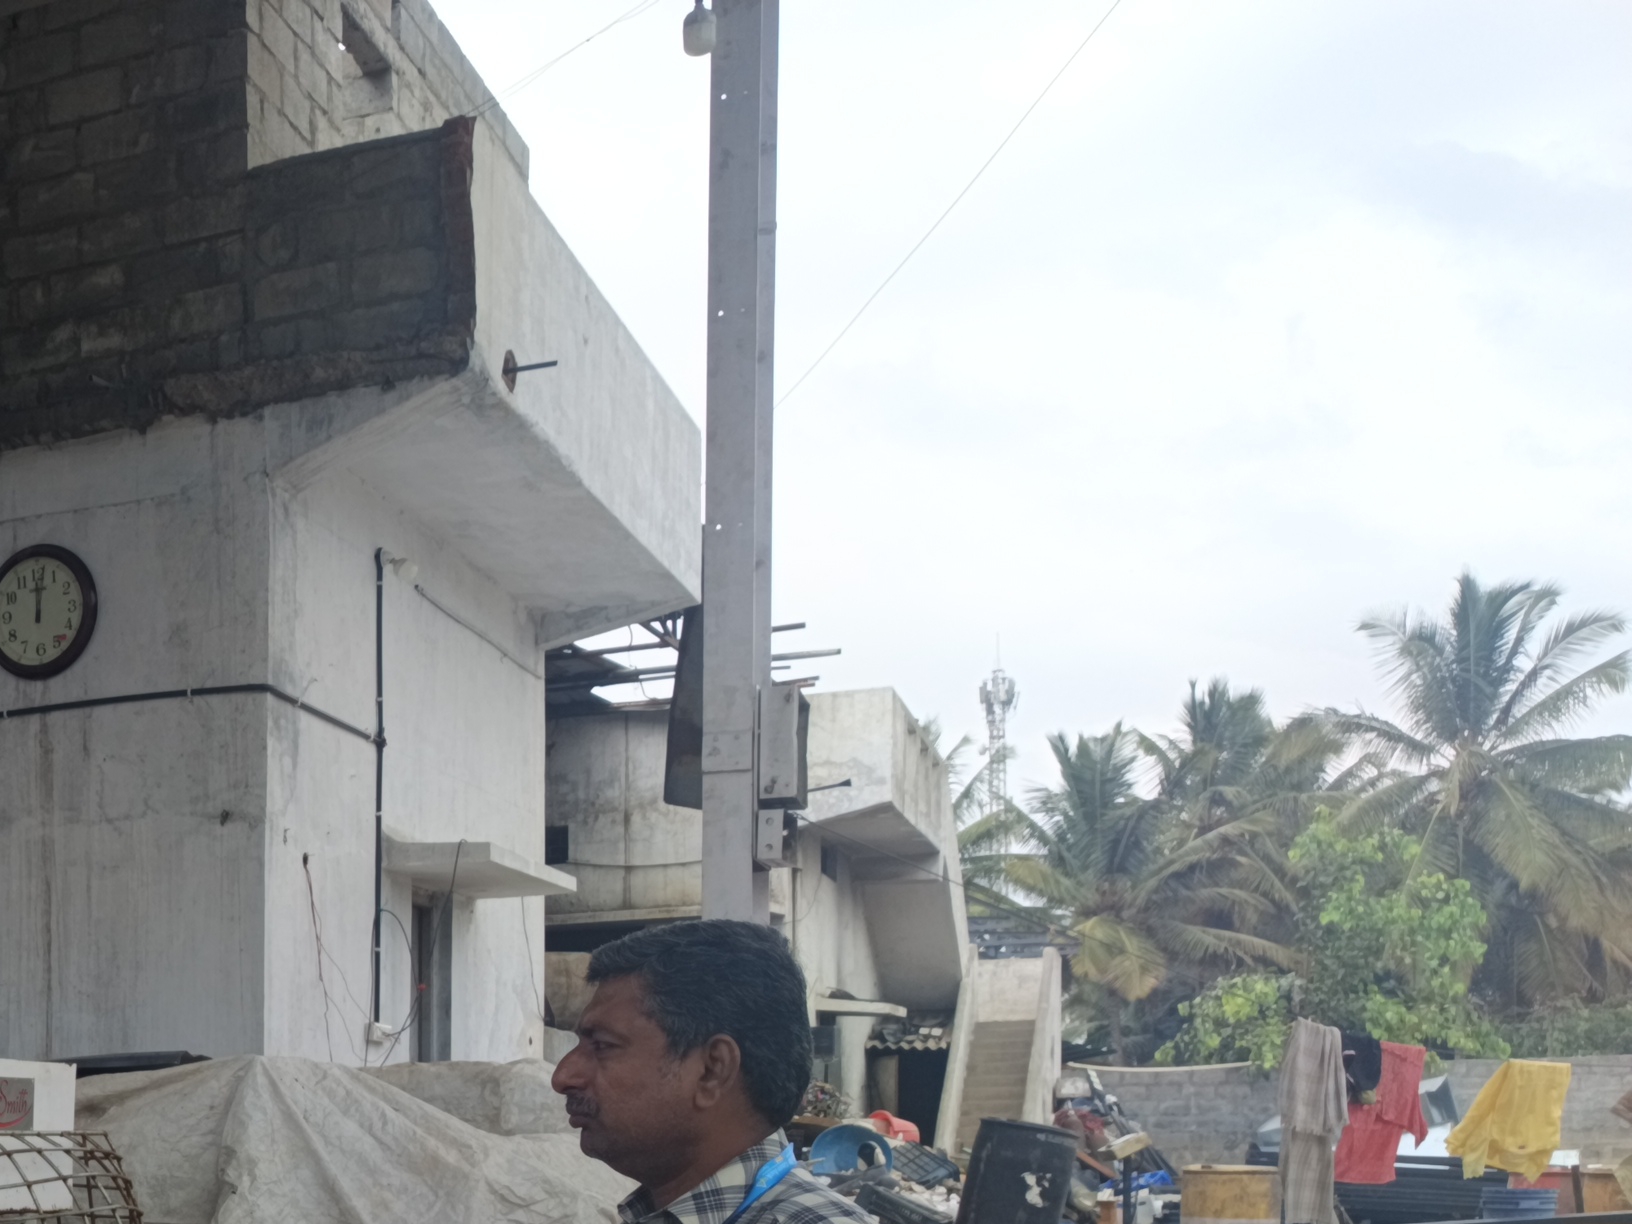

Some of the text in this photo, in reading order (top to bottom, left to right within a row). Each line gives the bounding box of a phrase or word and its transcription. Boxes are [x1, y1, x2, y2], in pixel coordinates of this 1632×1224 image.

[62, 581, 71, 595] 2
[6, 591, 17, 605] 10
[67, 599, 77, 613] 3
[2, 611, 13, 625] 9
[8, 629, 17, 642] 8
[21, 640, 29, 654] 7
[36, 643, 46, 656] 6
